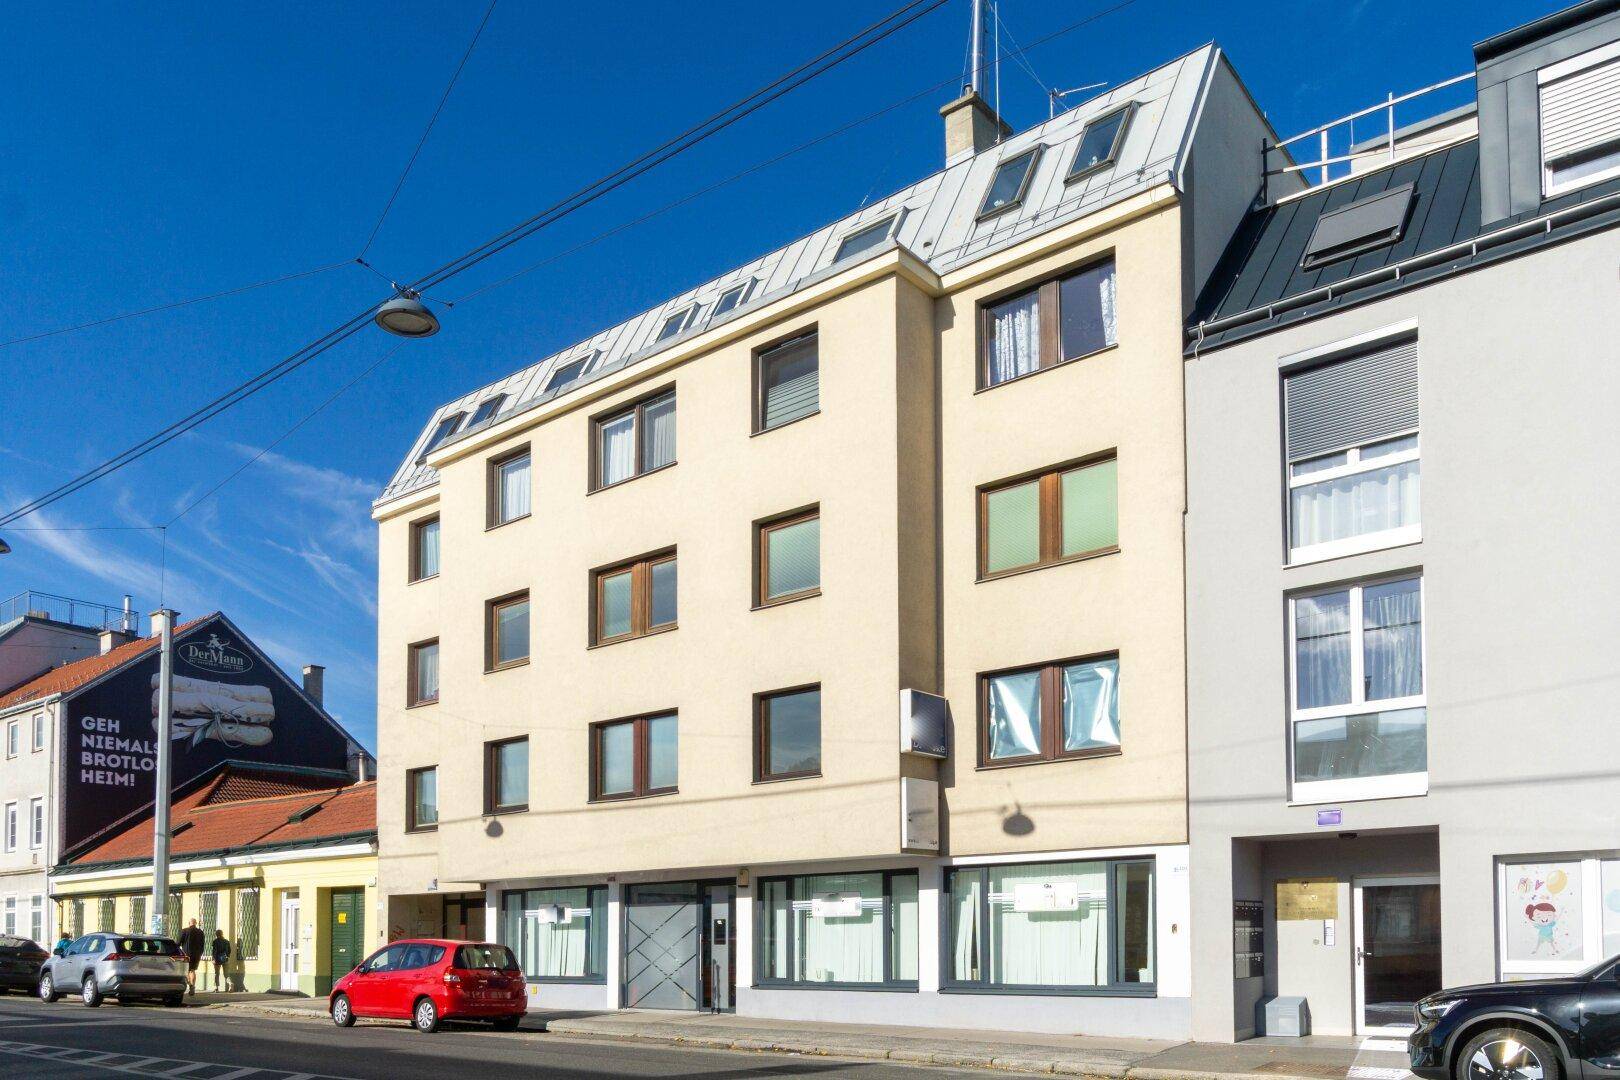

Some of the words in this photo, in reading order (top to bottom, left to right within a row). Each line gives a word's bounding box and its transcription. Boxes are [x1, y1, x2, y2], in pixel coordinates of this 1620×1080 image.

[81, 716, 120, 733] GEH
[81, 751, 157, 771] BROTLO
[81, 769, 135, 786] HEIM!
